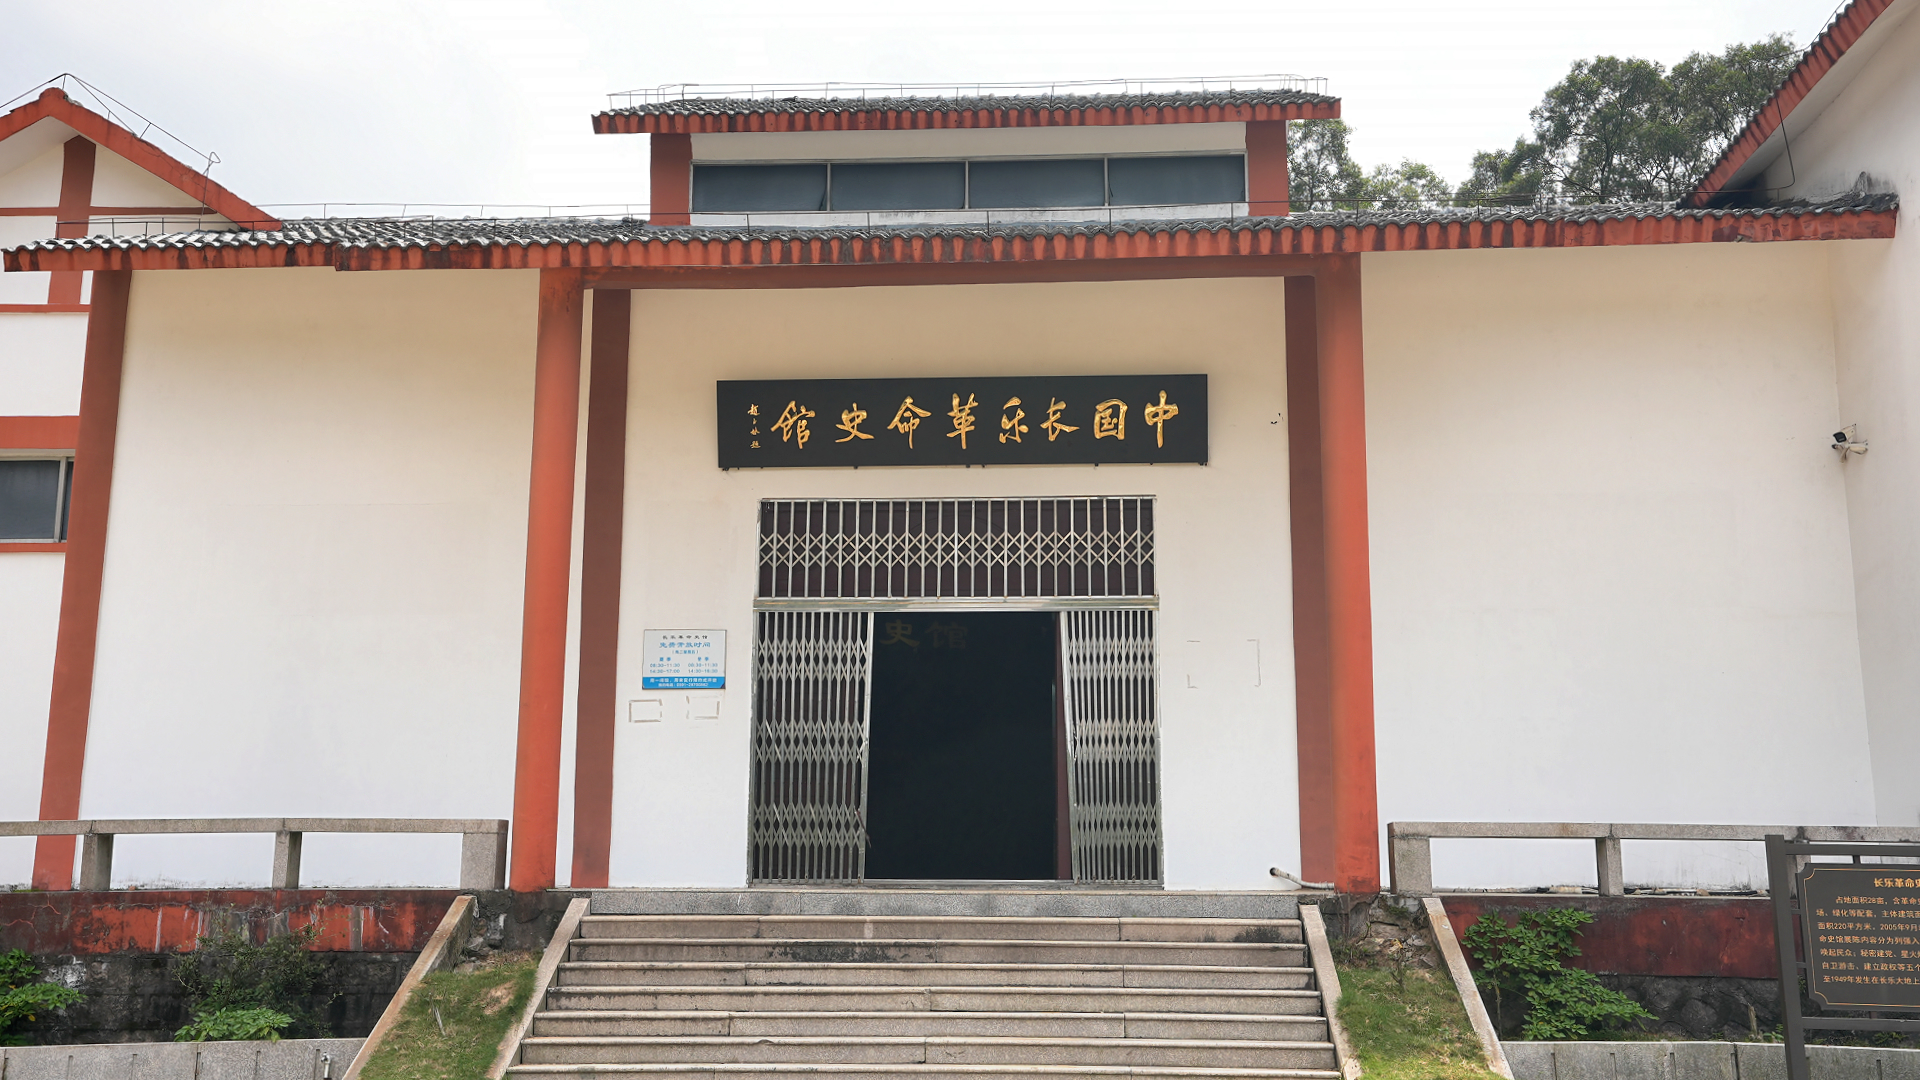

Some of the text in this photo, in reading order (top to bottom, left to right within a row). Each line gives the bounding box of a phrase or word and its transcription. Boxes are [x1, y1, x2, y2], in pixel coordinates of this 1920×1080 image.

[659, 641, 711, 649] 免费开放时间
